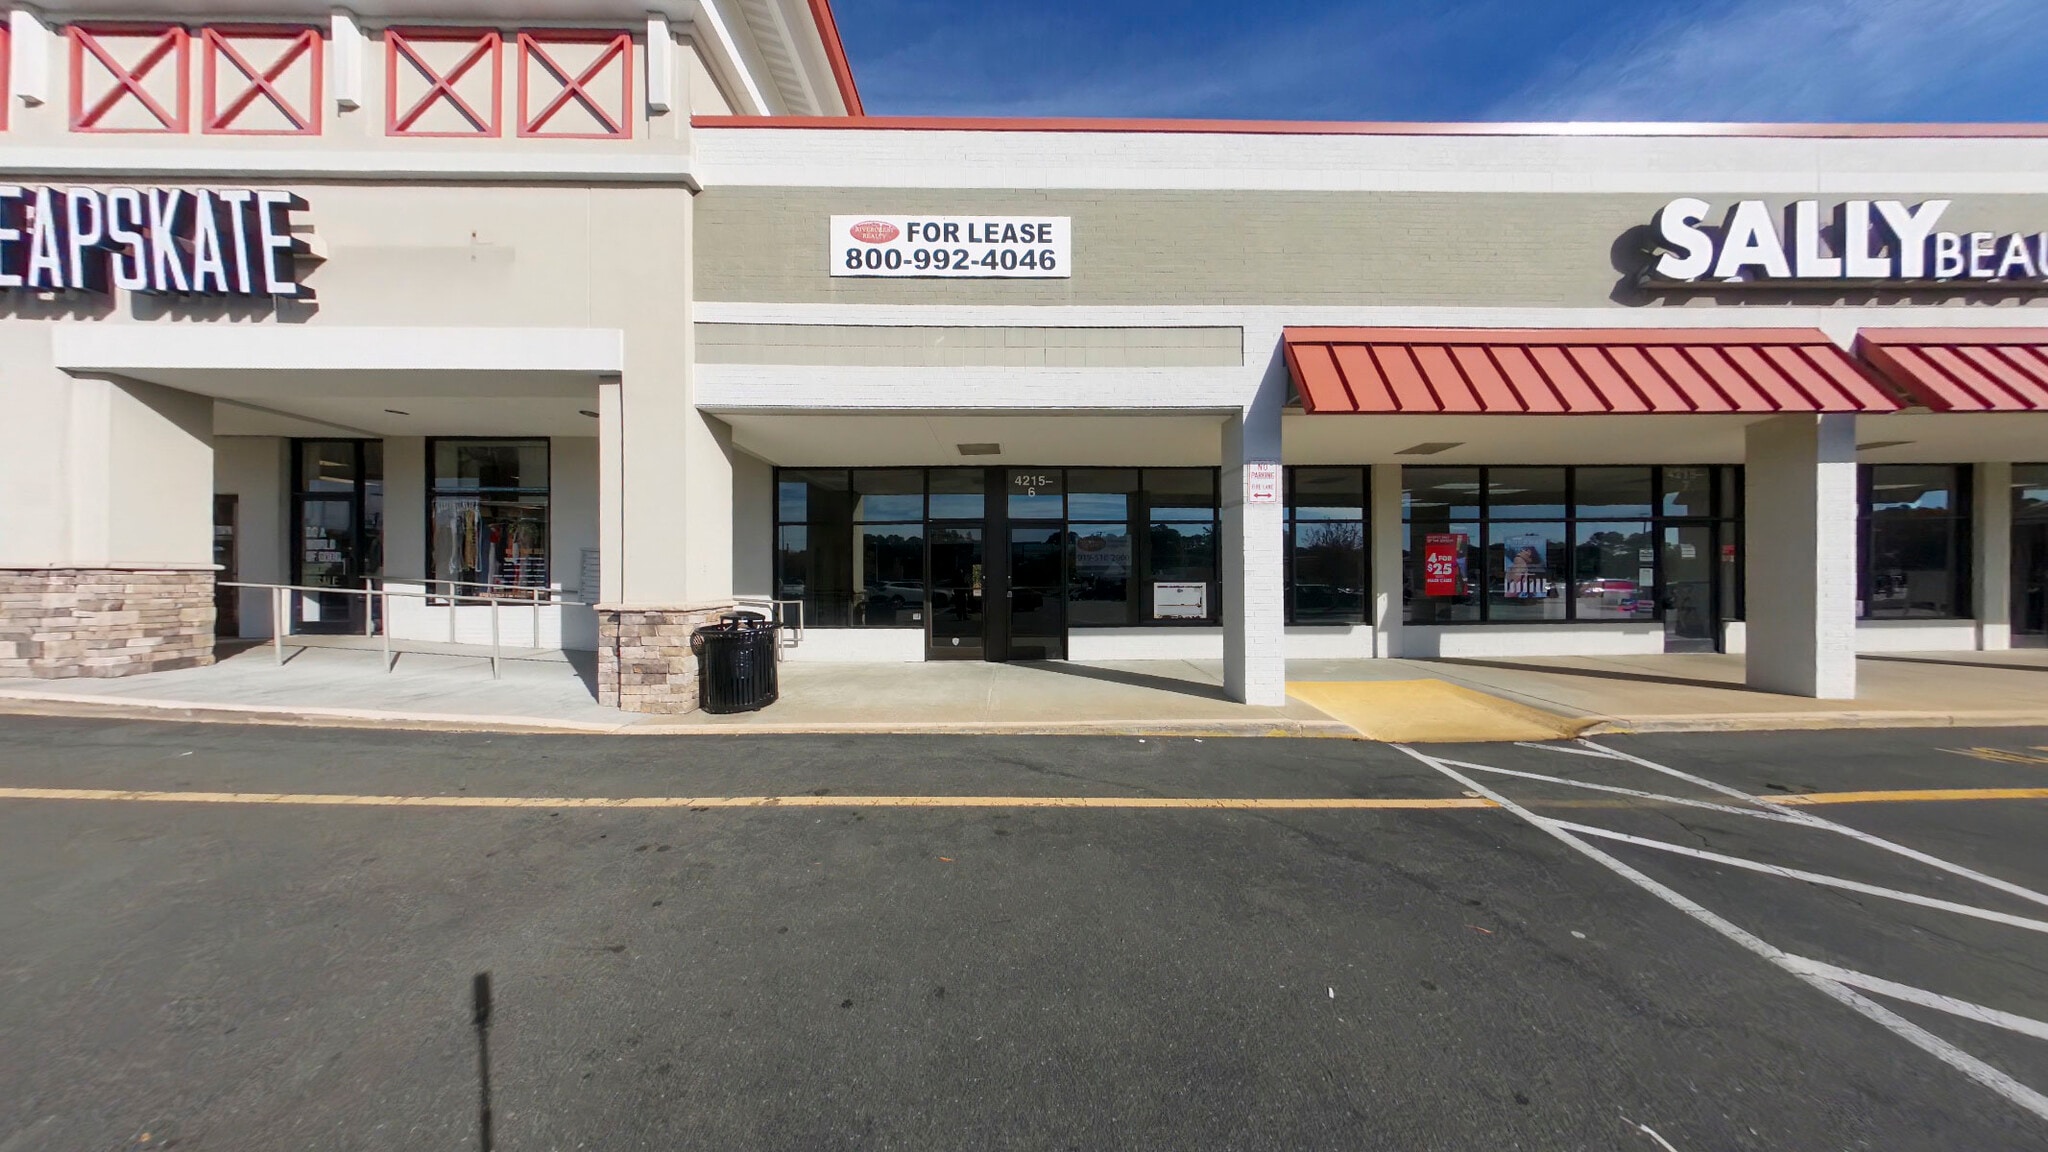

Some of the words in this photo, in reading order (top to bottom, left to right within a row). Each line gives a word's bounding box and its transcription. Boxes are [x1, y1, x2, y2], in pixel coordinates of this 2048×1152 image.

[907, 222, 960, 243] FOR
[968, 223, 1053, 244] LEASE
[1655, 197, 1952, 281] SALLY
[846, 248, 1056, 271] 800-992-4046
[1257, 463, 1269, 471] NO
[1014, 475, 1053, 486] 4215-
[1250, 472, 1275, 480] PARKING
[1027, 487, 1036, 497] 6
[1428, 552, 1437, 563] 4
[1427, 563, 1453, 575] $25
